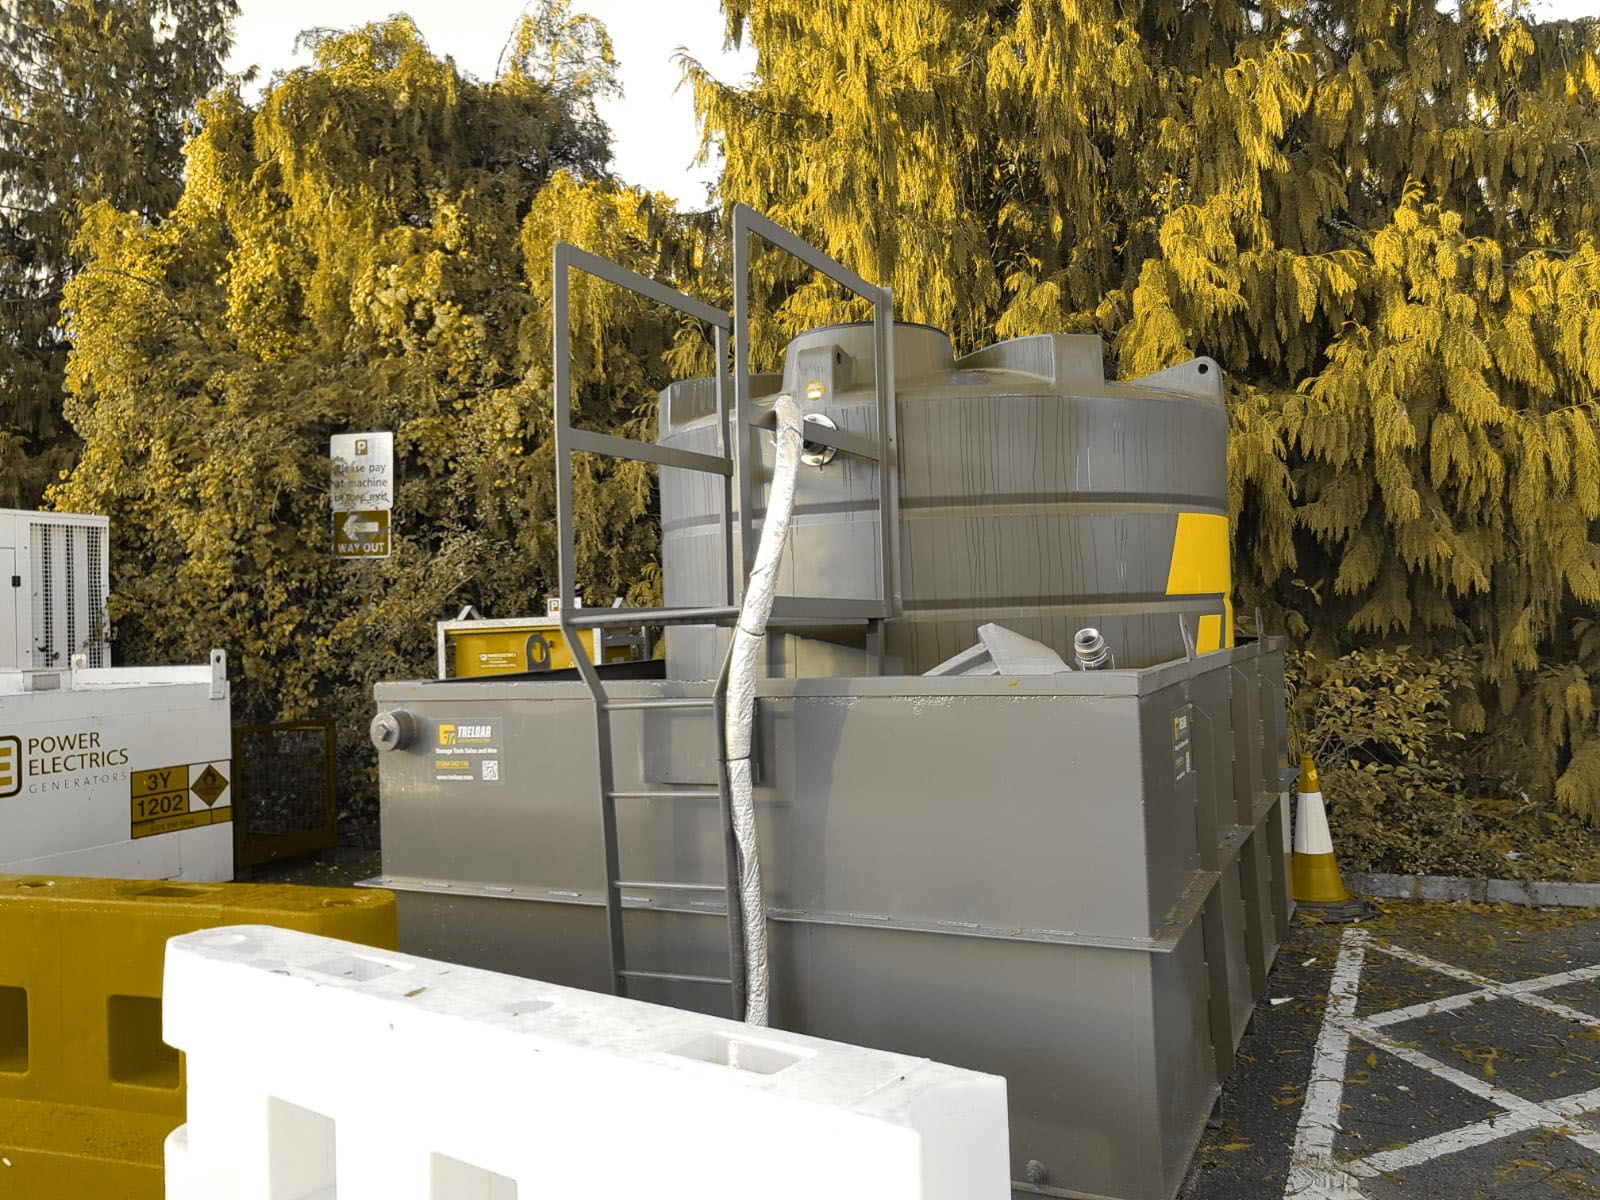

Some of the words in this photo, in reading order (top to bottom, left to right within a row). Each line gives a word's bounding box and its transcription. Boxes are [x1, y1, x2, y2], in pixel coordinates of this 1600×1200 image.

[357, 441, 366, 455] P
[369, 464, 386, 474] pay
[348, 477, 388, 488] machine
[338, 543, 360, 553] WAY
[363, 542, 385, 553] OUT
[457, 725, 492, 738] TRELOAR
[28, 732, 101, 755] POWER
[28, 748, 129, 776] ELECTRICS
[29, 771, 128, 794] GENERATORS
[147, 771, 172, 791] 3Y
[137, 794, 184, 817] 1202
